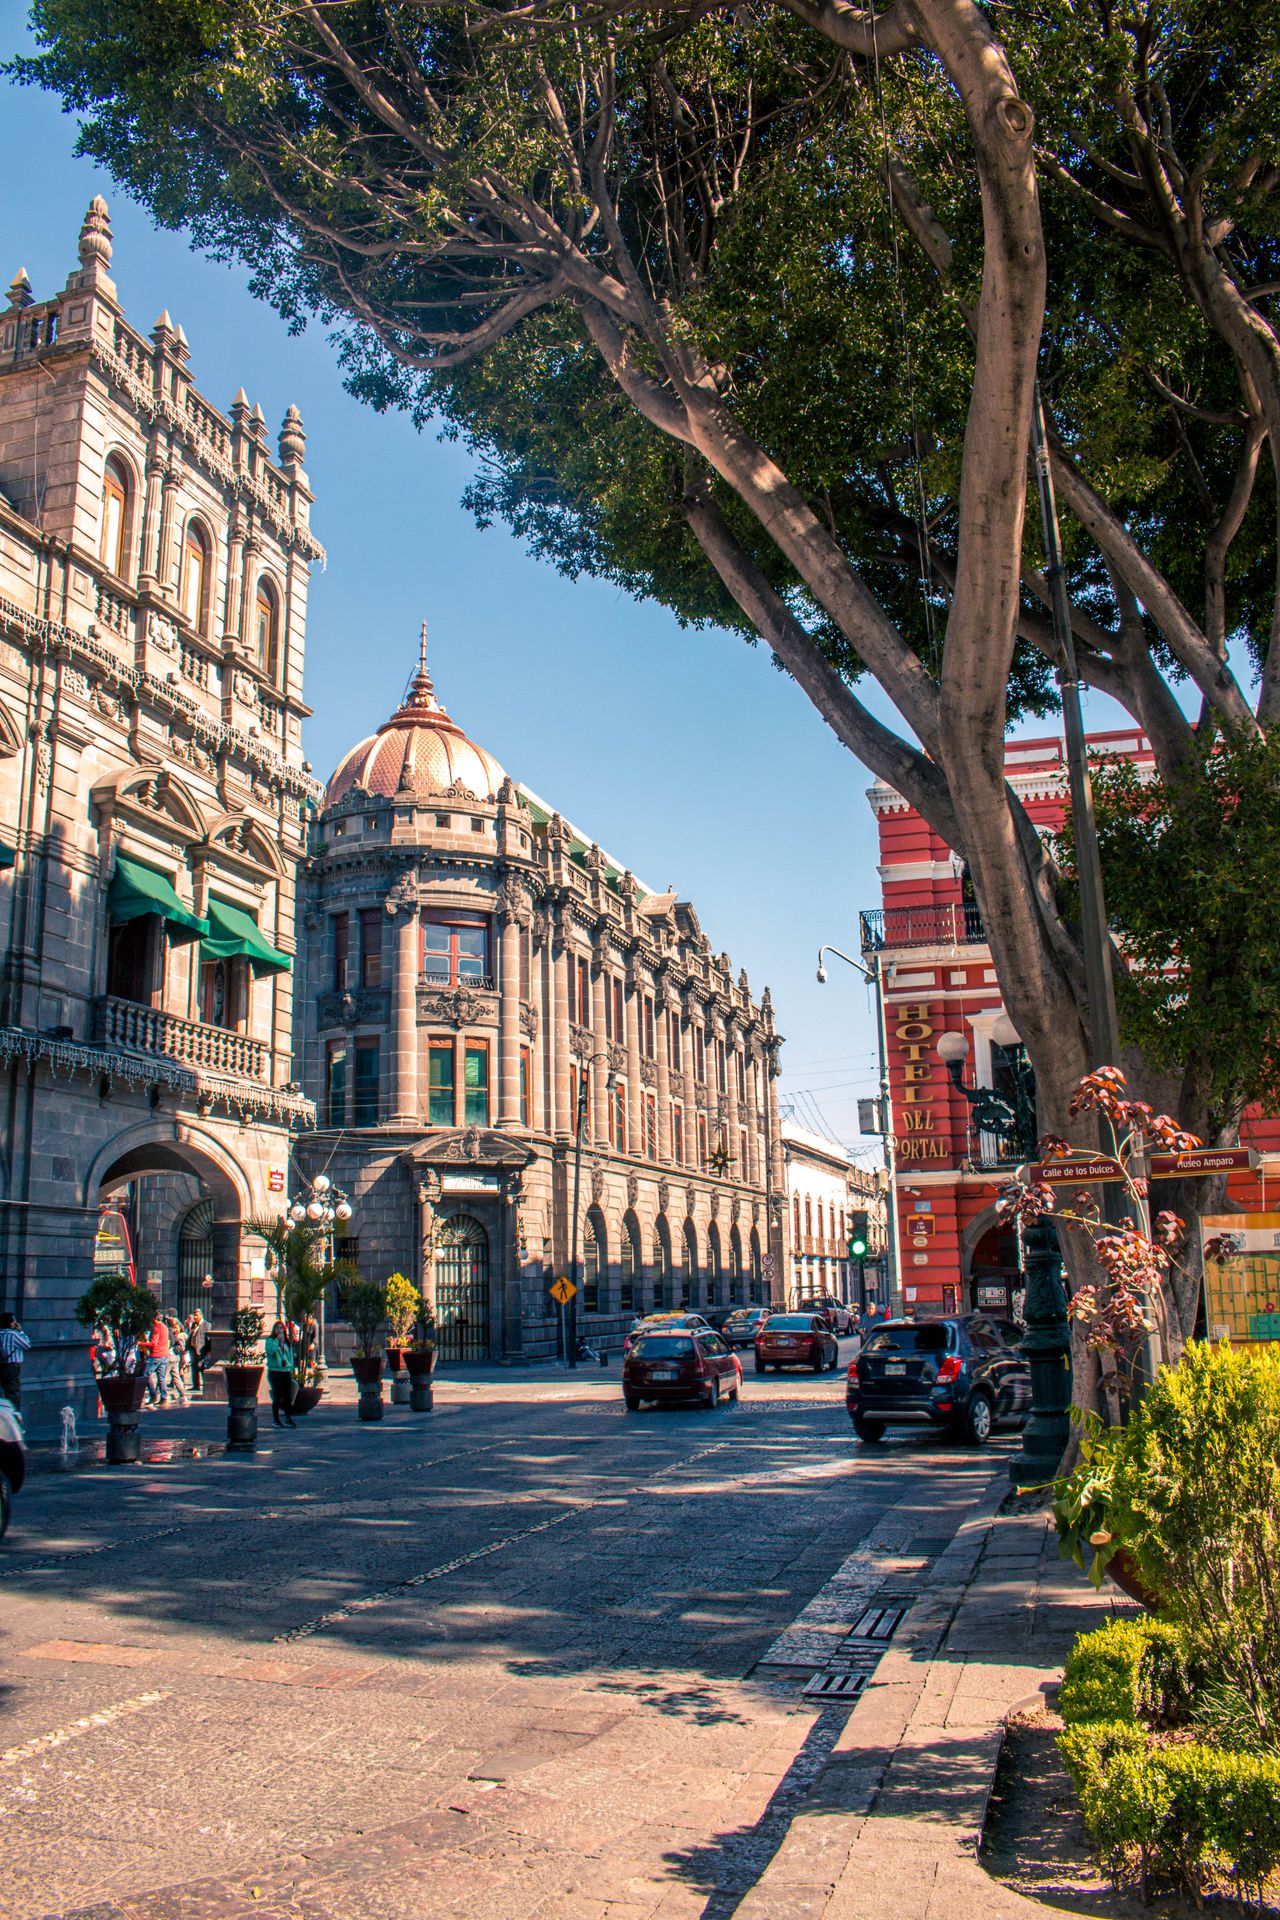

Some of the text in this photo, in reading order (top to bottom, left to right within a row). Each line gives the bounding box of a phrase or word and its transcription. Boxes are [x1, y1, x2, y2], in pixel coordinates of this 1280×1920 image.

[895, 1003, 933, 1103] HOTEL
[902, 1109, 934, 1131] DEL
[1042, 1165, 1114, 1177] Calle de los Dulces
[1176, 1157, 1234, 1168] Museo Amparo
